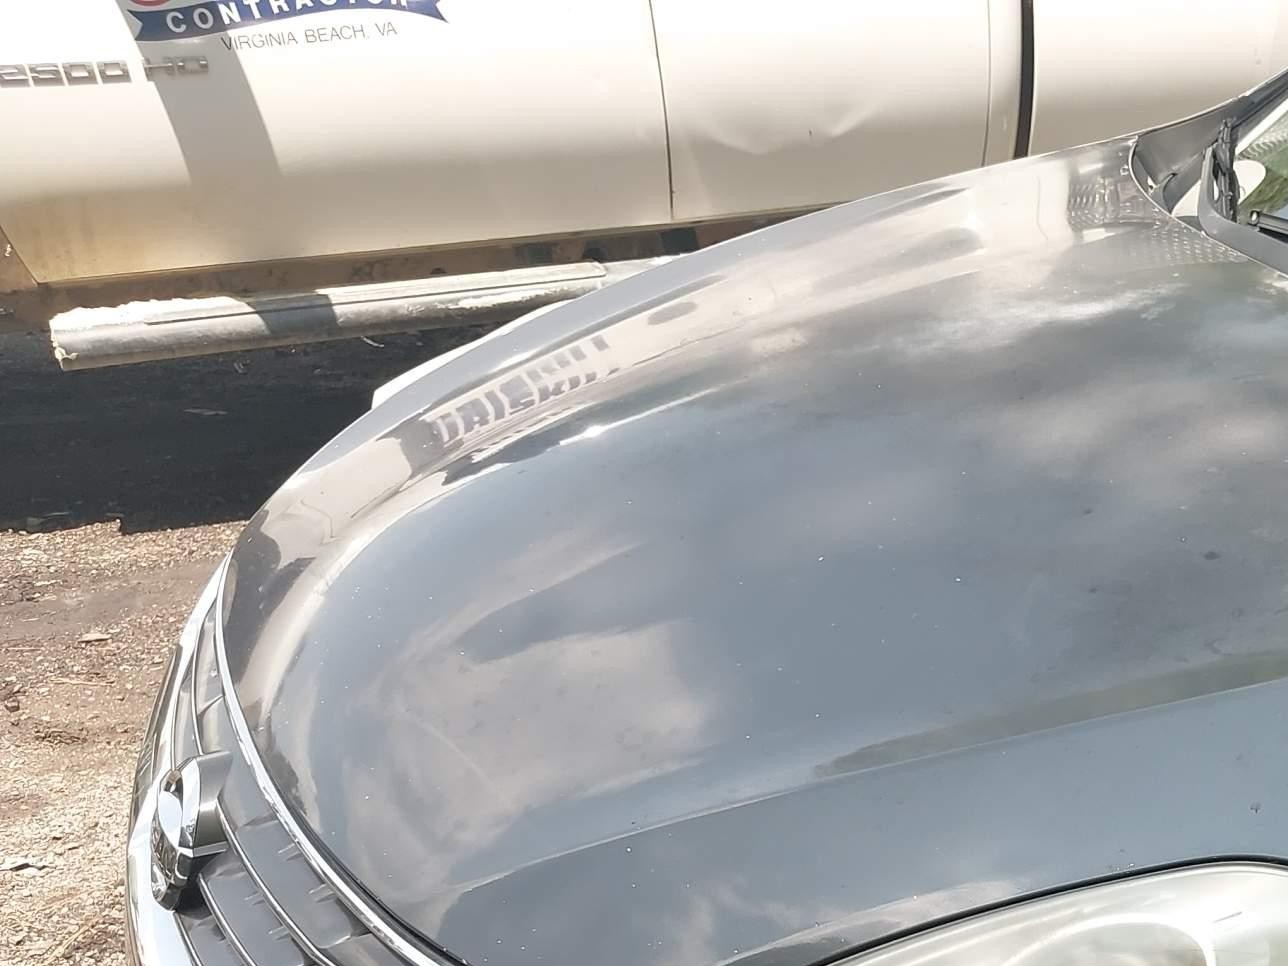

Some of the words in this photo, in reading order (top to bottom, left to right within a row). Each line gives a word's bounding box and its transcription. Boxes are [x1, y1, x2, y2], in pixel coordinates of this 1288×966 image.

[221, 32, 298, 51] VIRGINIA
[376, 22, 398, 38] VA
[0, 60, 132, 87] 2500
